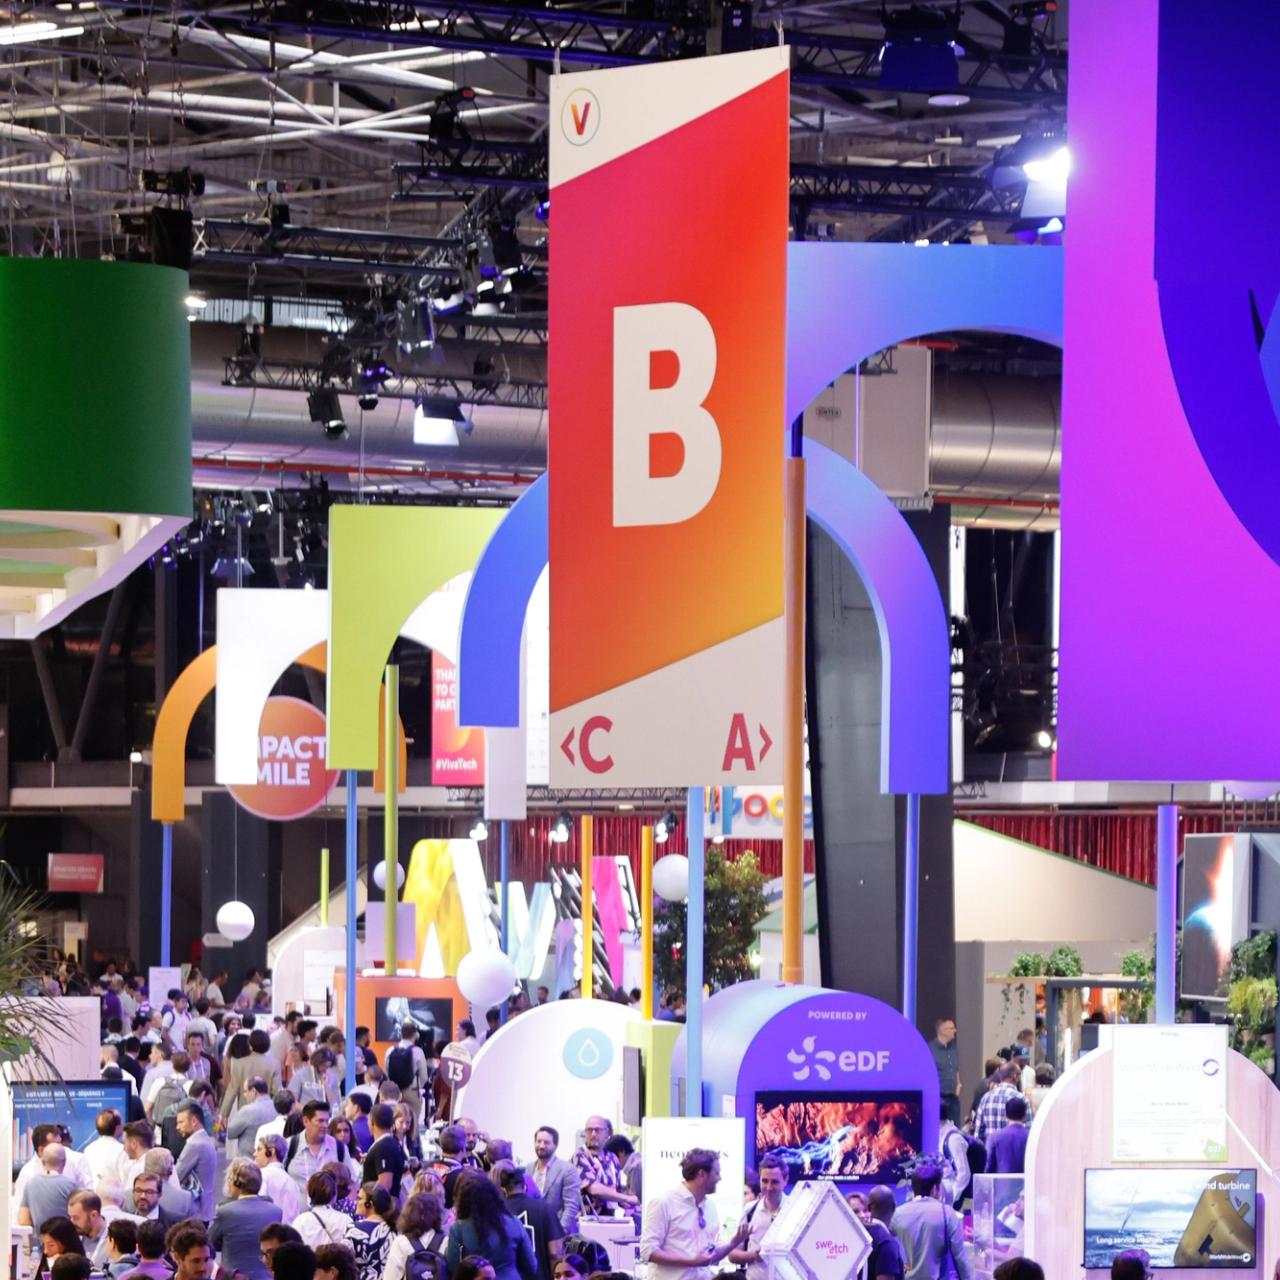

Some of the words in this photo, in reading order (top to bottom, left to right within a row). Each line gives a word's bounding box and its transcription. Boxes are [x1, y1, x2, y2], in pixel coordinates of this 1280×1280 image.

[613, 302, 722, 528] B
[256, 735, 327, 759] PACT
[579, 716, 614, 774] C
[722, 713, 756, 771] A
[435, 758, 478, 771] #VivaTech
[808, 1010, 854, 1020] POWERED
[855, 1011, 867, 1020] BY
[447, 1061, 464, 1082] 13
[1218, 1180, 1251, 1191] turbine
